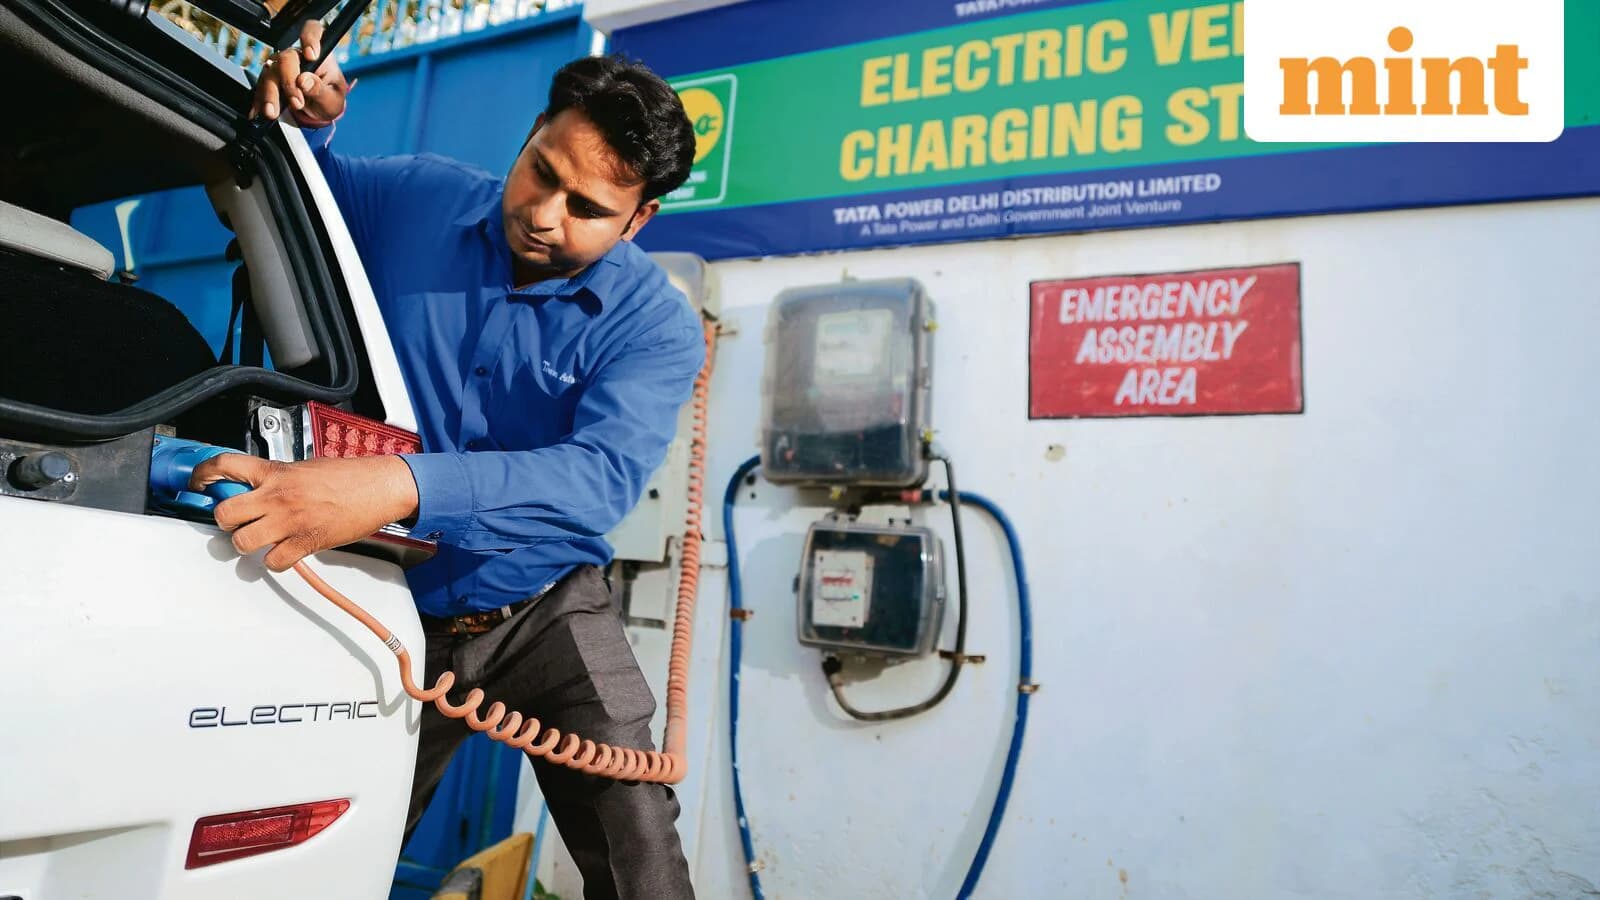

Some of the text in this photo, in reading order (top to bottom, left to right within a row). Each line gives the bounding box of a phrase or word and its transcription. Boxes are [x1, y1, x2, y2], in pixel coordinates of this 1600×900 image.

[860, 19, 1128, 107] ELECTRIC
[840, 82, 1246, 181] CHARGING ST
[833, 173, 1221, 225] TATA POWER DELHI DISTRIBUTION LIMITED
[860, 199, 1182, 236] A Tata Power and Delhi Government Joint Venture
[1059, 275, 1257, 325] EMERGENCY
[1075, 321, 1248, 364] ASSEMBLY
[1113, 367, 1198, 406] AREA
